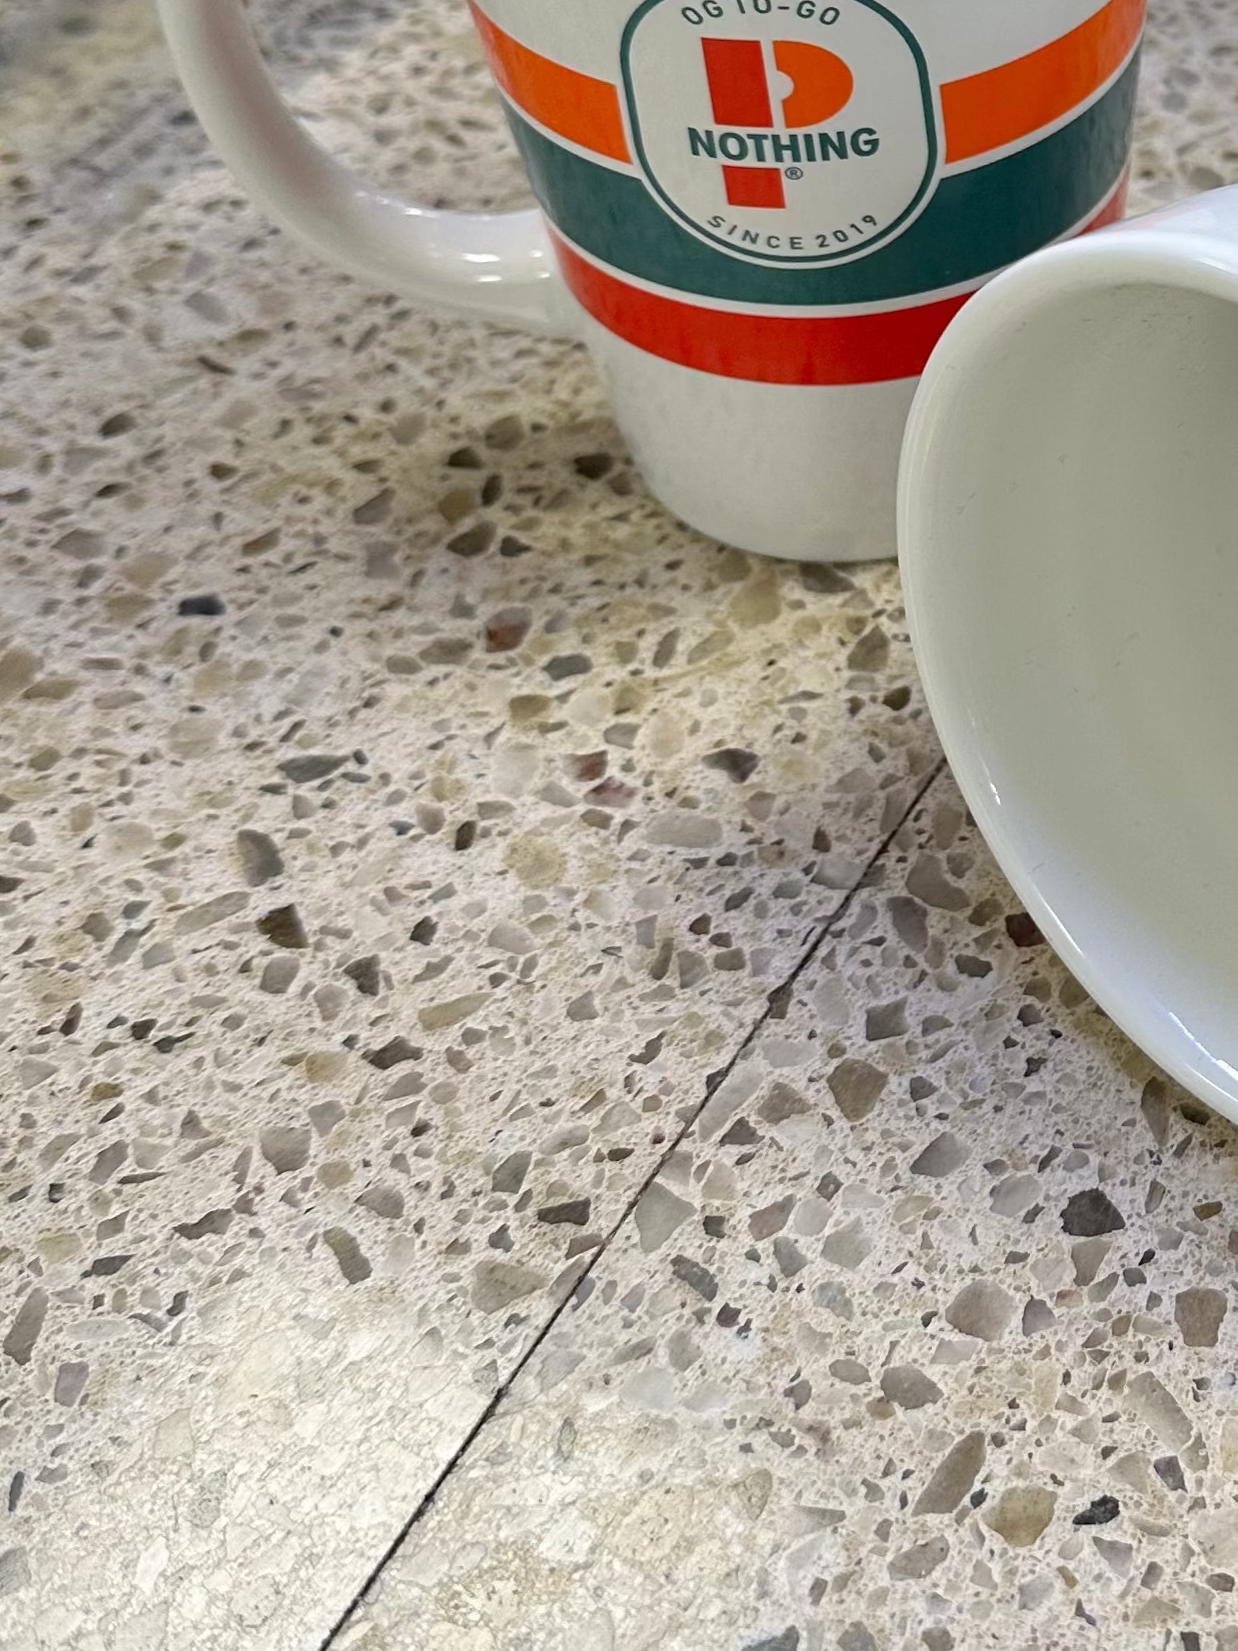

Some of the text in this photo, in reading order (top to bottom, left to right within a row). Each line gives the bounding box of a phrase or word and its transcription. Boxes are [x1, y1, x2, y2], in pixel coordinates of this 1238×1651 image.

[681, 0, 724, 26] OG
[687, 127, 880, 163] NOTHING
[707, 214, 878, 250] SINCE 2019
